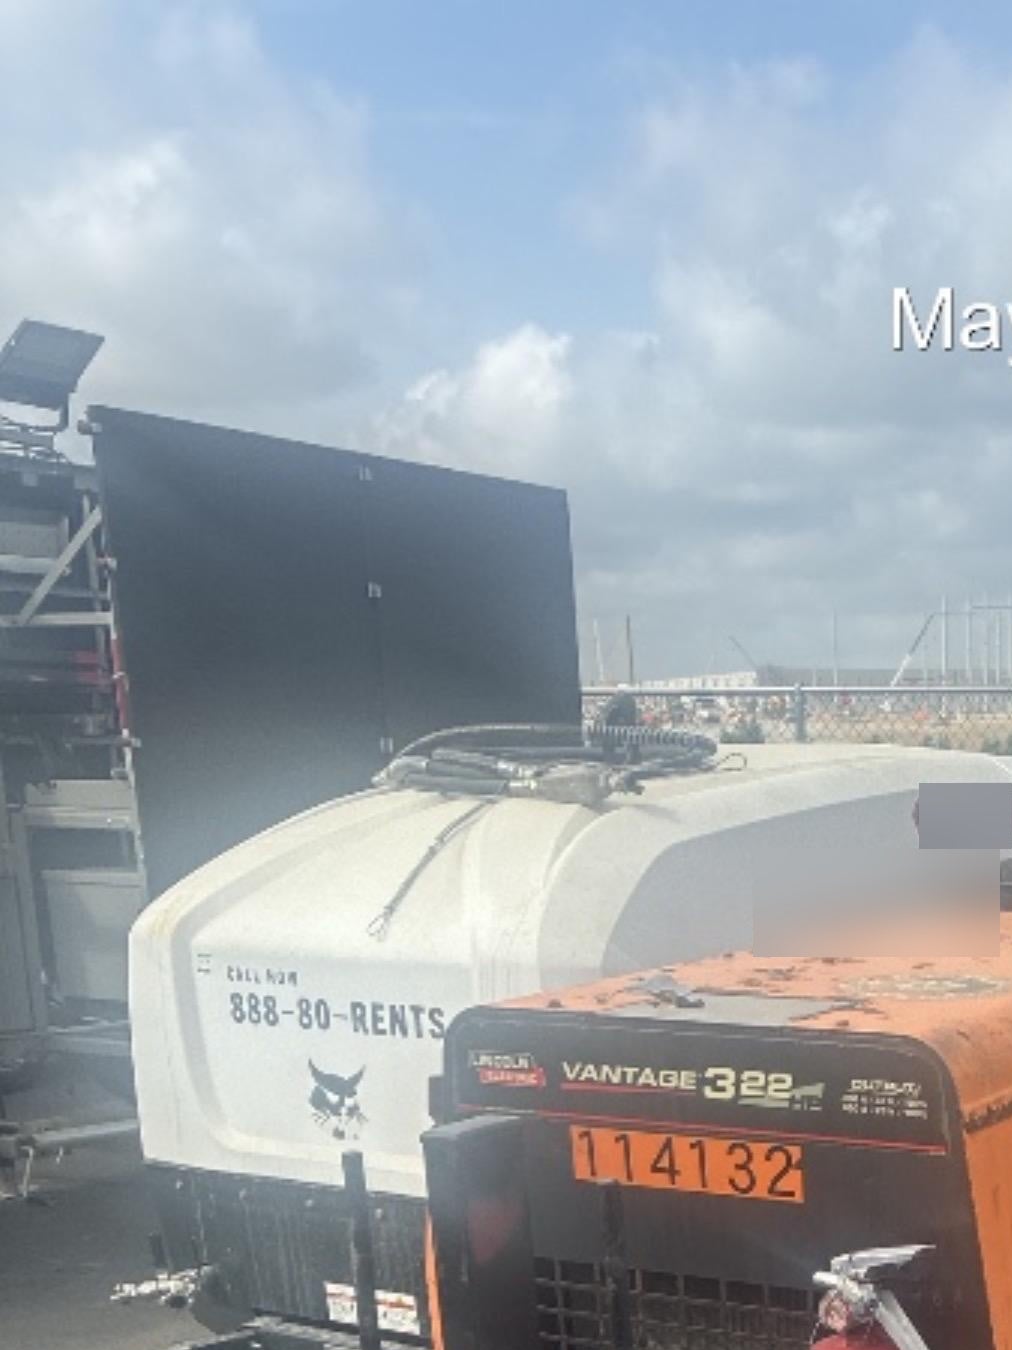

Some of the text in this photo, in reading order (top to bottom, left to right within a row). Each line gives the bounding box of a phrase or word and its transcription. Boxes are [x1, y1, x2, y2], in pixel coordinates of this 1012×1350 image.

[229, 991, 445, 1039] 888-80-RENTS
[562, 1060, 793, 1100] VANTAGE 322
[578, 1130, 797, 1198] 114132
